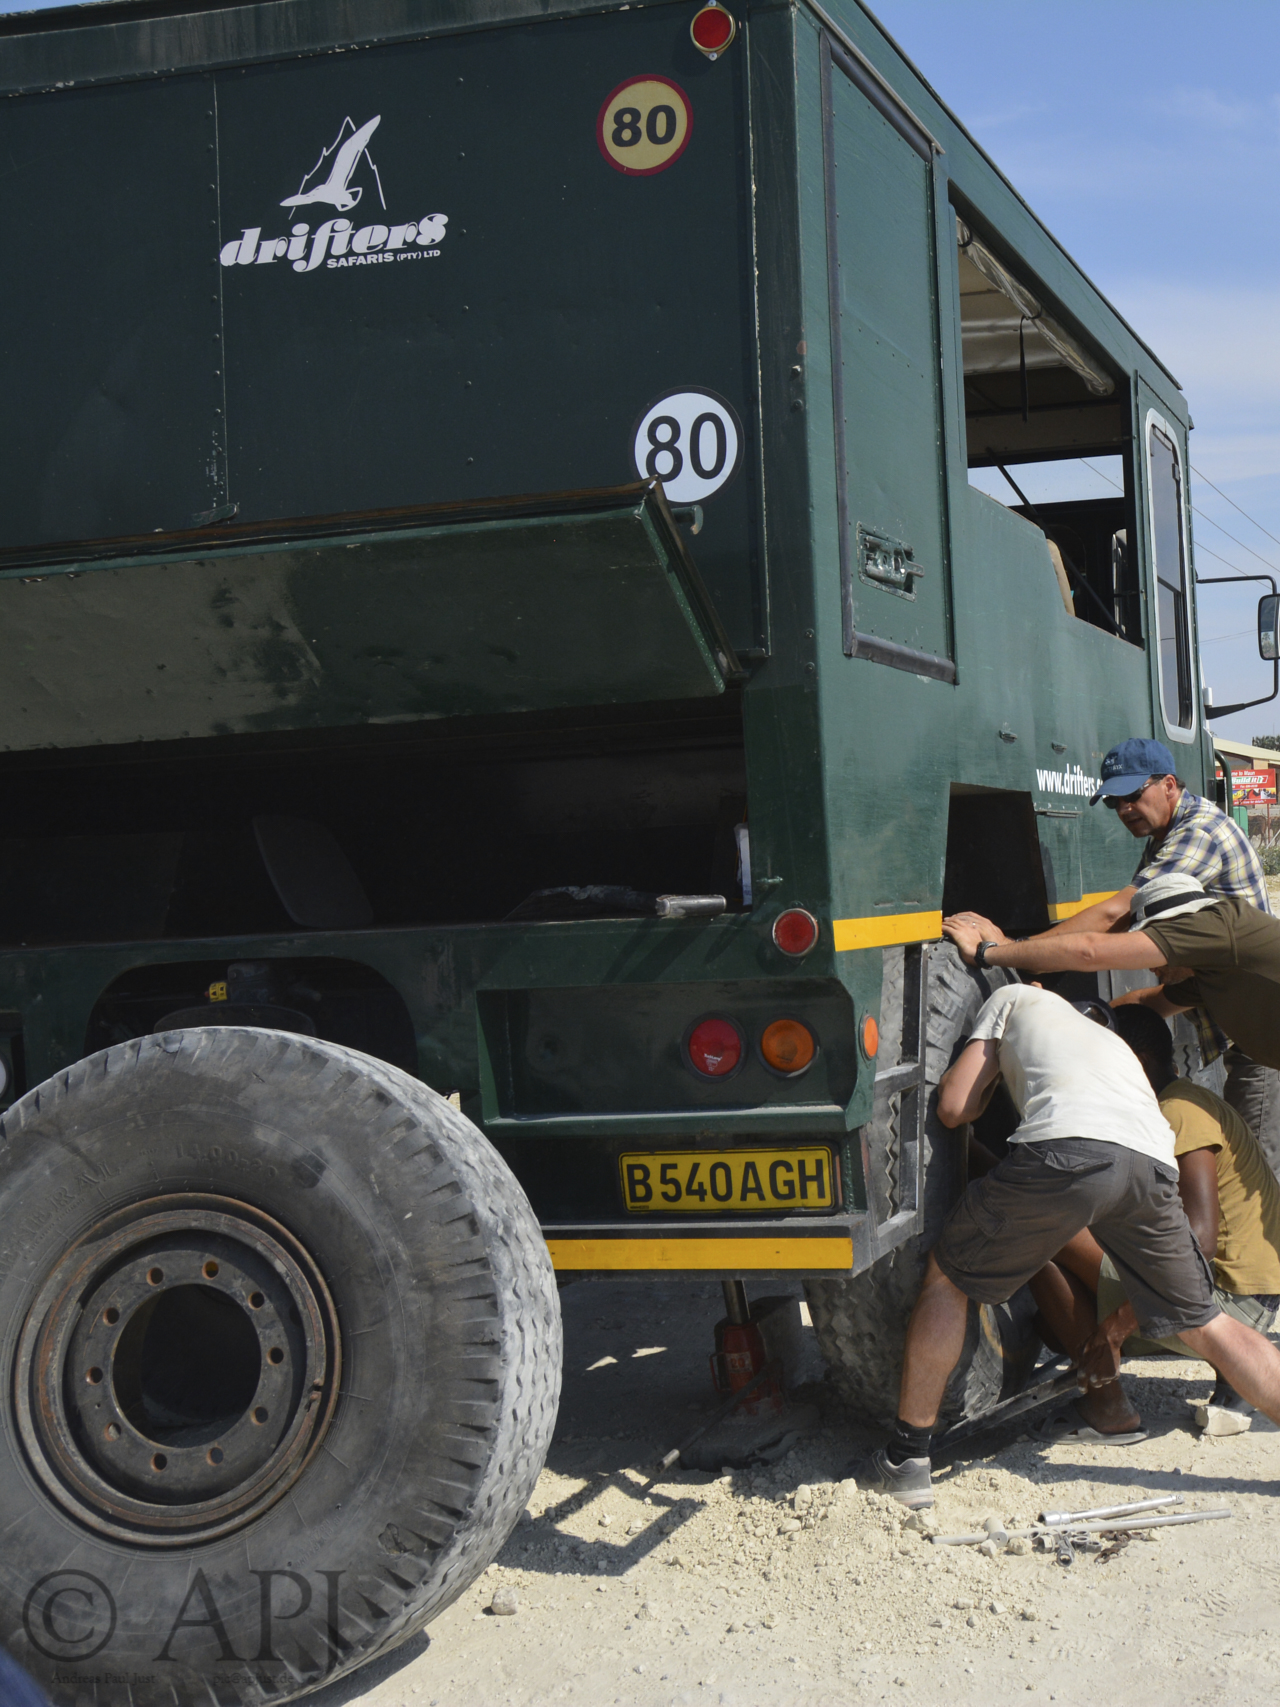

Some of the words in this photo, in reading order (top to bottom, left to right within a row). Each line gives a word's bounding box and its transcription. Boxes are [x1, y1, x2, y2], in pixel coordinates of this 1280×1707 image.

[612, 105, 677, 148] 80
[219, 213, 449, 273] drifters
[326, 253, 395, 269] SAFARIS
[396, 251, 422, 262] (PTY)
[423, 249, 441, 259] LTD
[645, 412, 727, 483] 80
